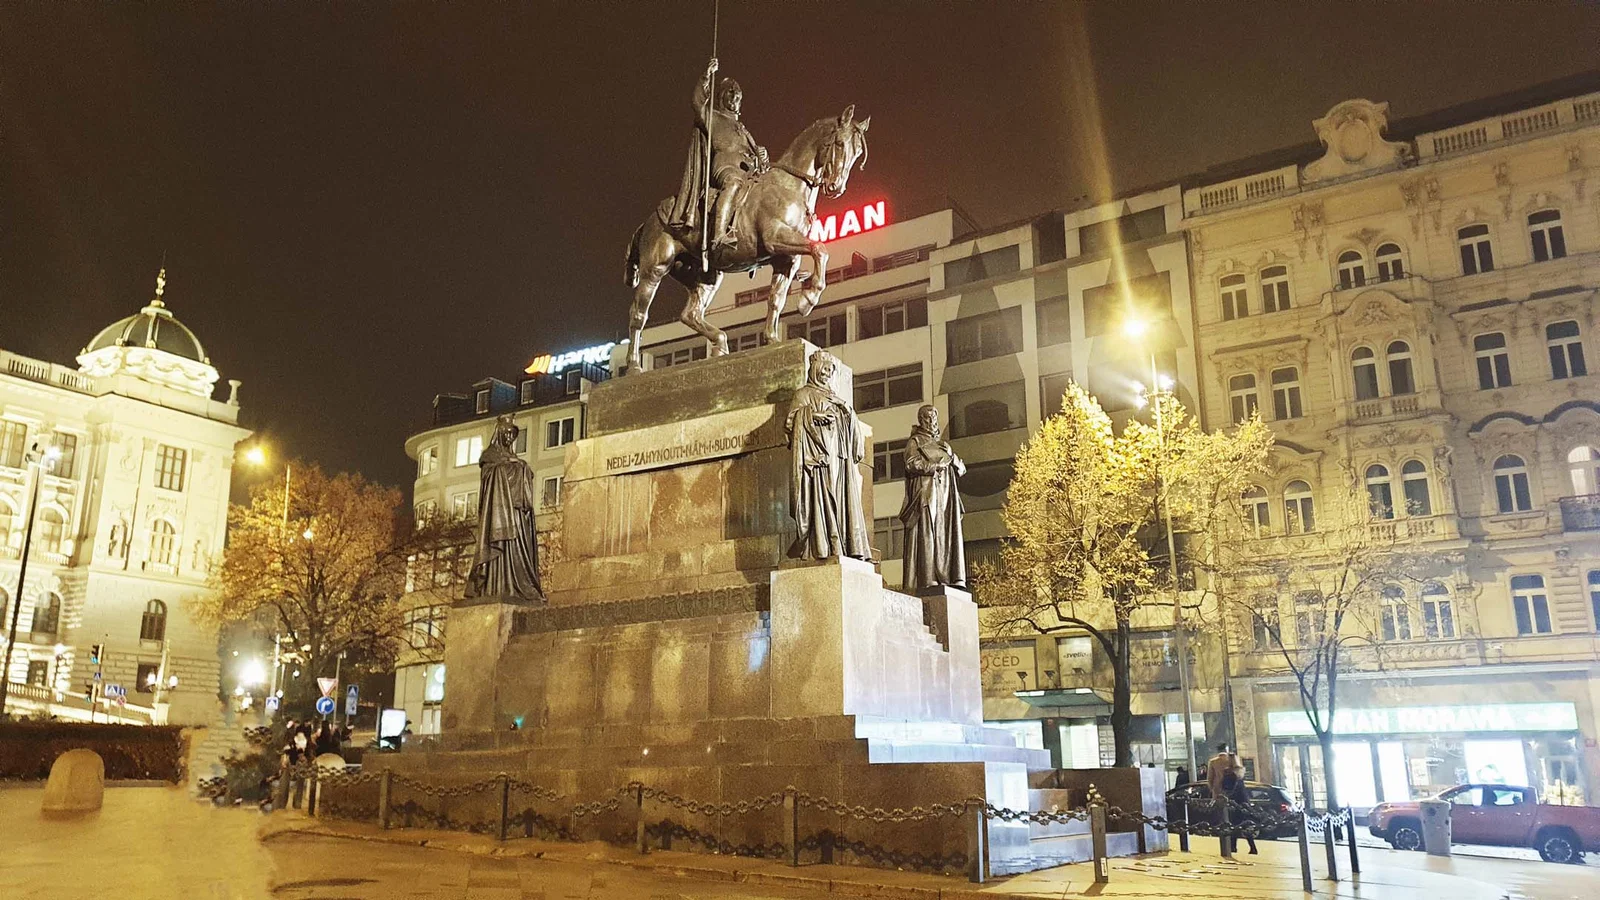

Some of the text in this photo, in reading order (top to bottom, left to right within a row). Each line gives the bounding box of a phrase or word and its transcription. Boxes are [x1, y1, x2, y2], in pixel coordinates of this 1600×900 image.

[809, 201, 885, 242] MAN
[606, 454, 631, 470] NEDEJ
[1317, 709, 1389, 734] RAN
